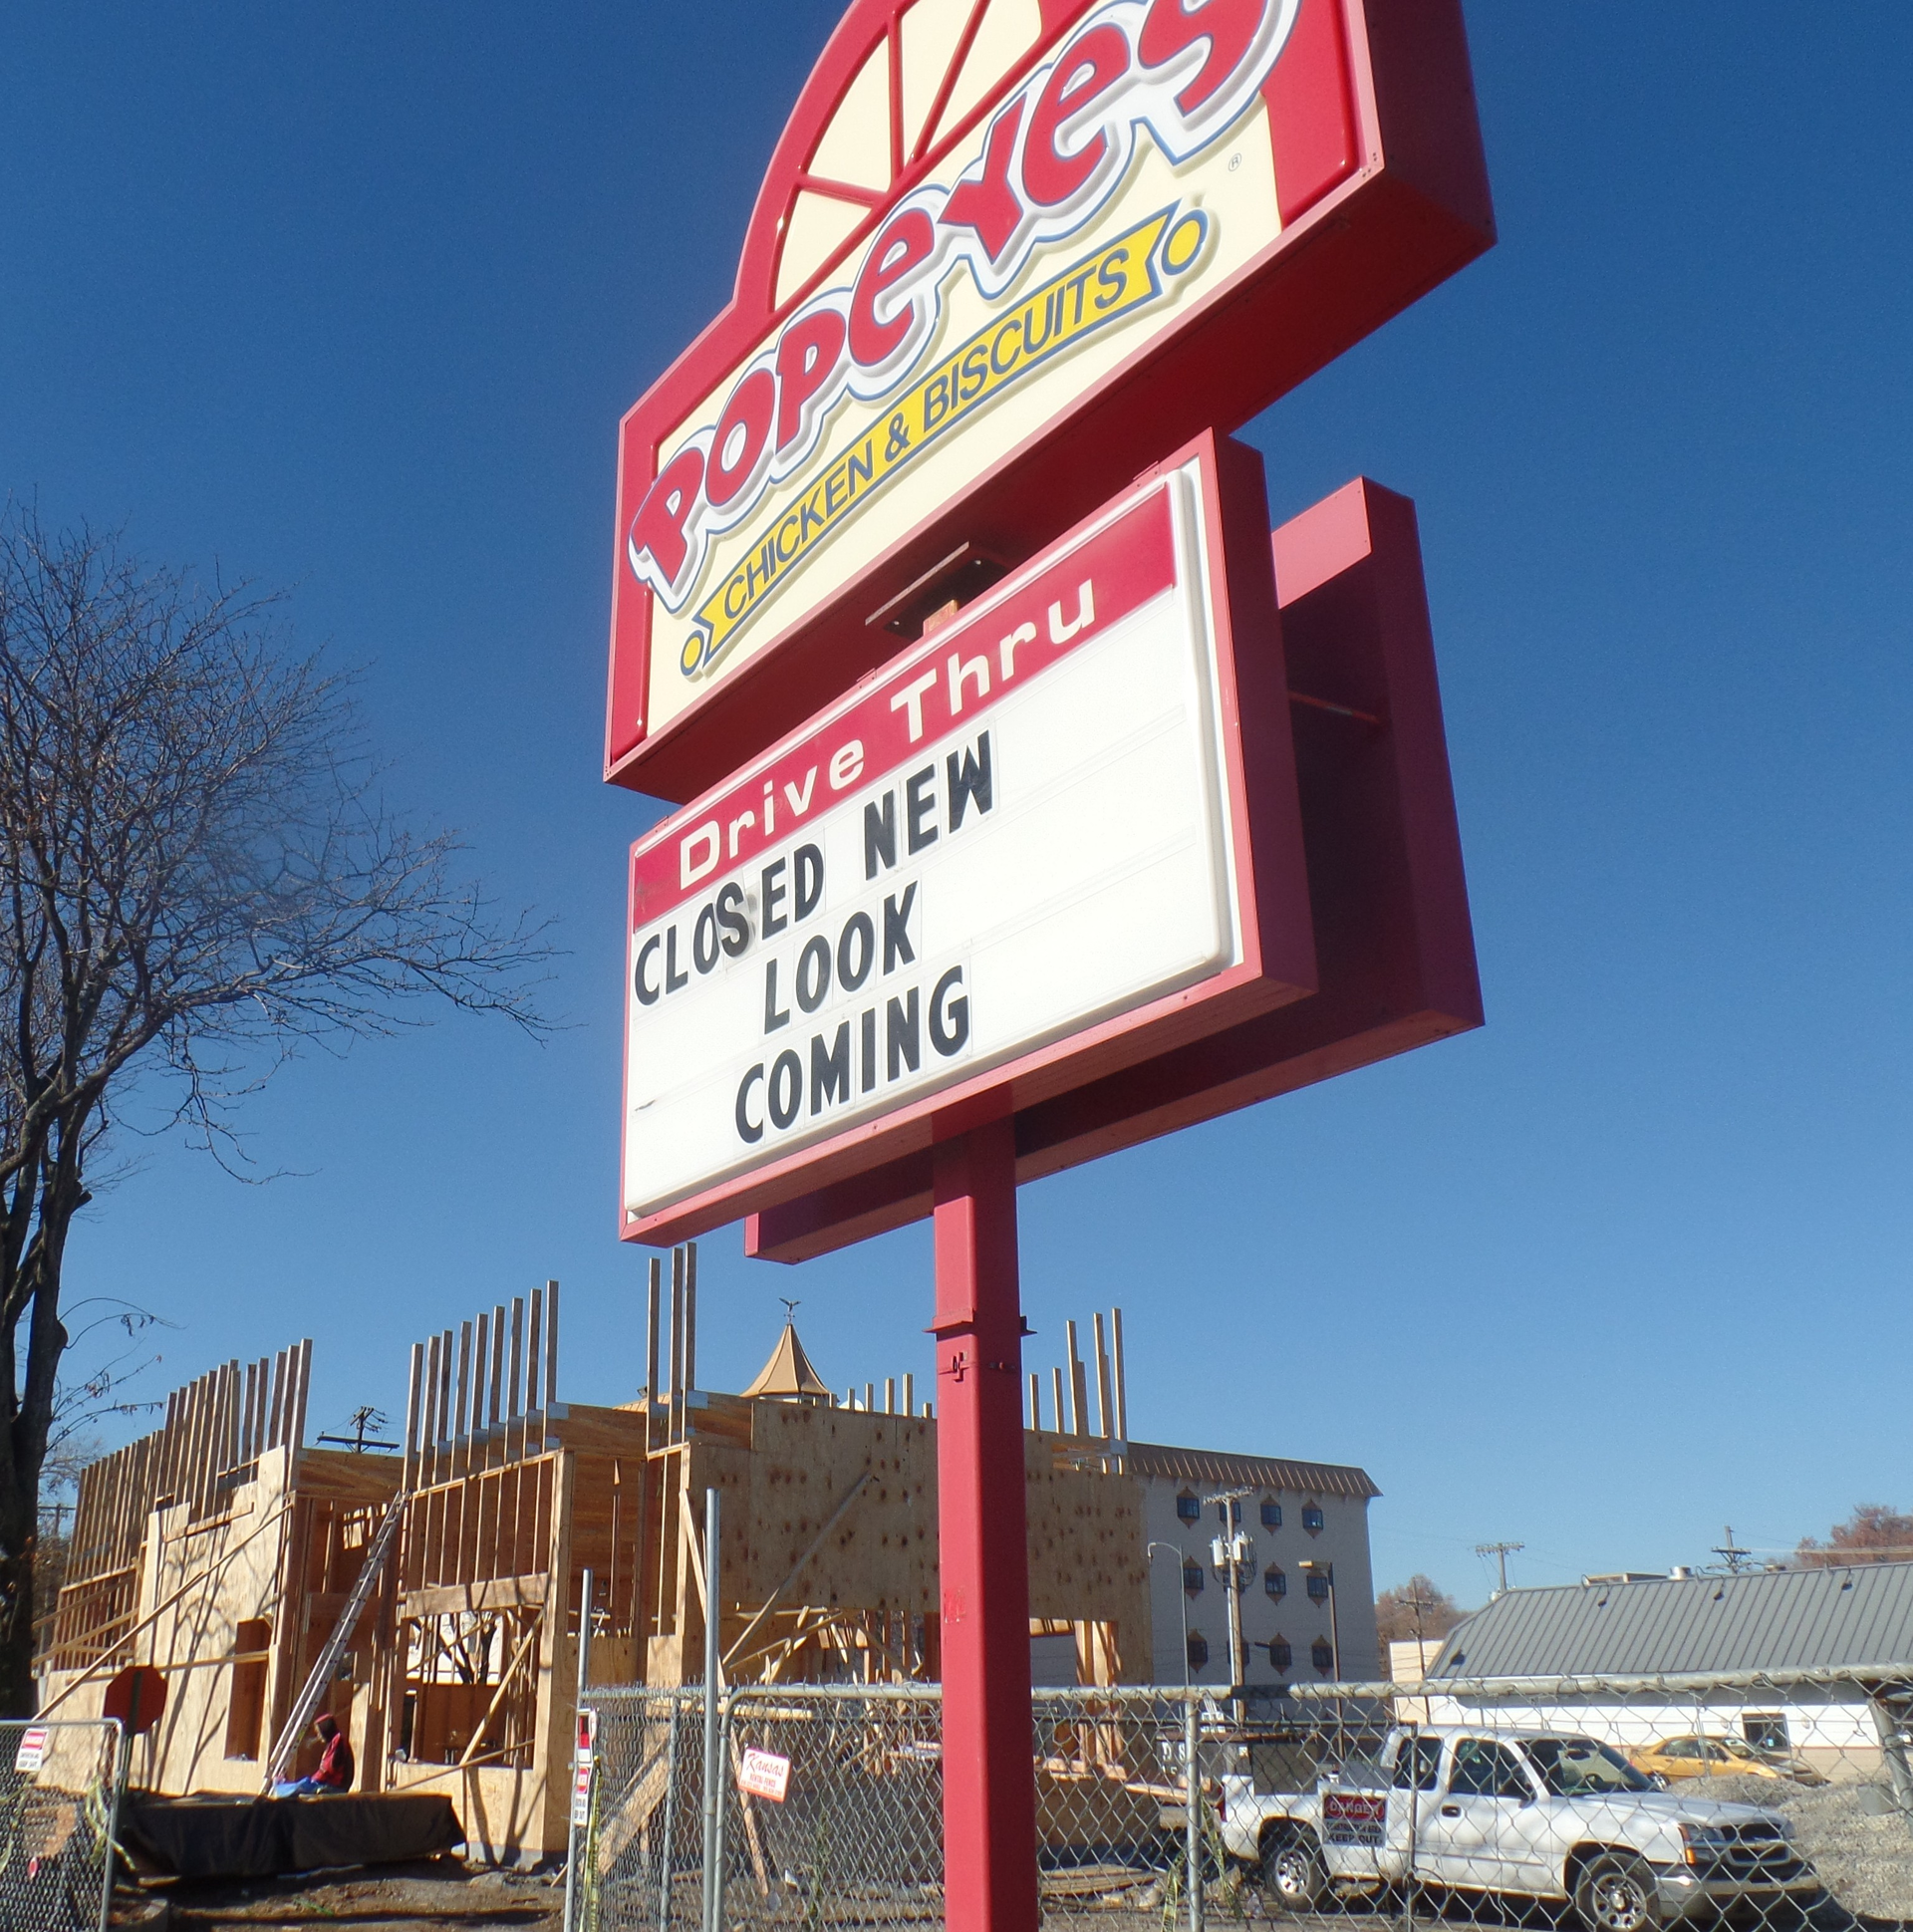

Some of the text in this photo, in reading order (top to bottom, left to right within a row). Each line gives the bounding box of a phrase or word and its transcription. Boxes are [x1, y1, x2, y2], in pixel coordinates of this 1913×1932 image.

[723, 248, 1129, 618] CHICKEN & BISCUITS
[680, 578, 1096, 891] Drive Thru
[635, 729, 993, 1006] CLOSED NEW
[764, 880, 919, 1035] LOOK
[735, 965, 969, 1144] COMING
[746, 1753, 784, 1777] Kansas
[1328, 1832, 1379, 1844] KEEP OUT
